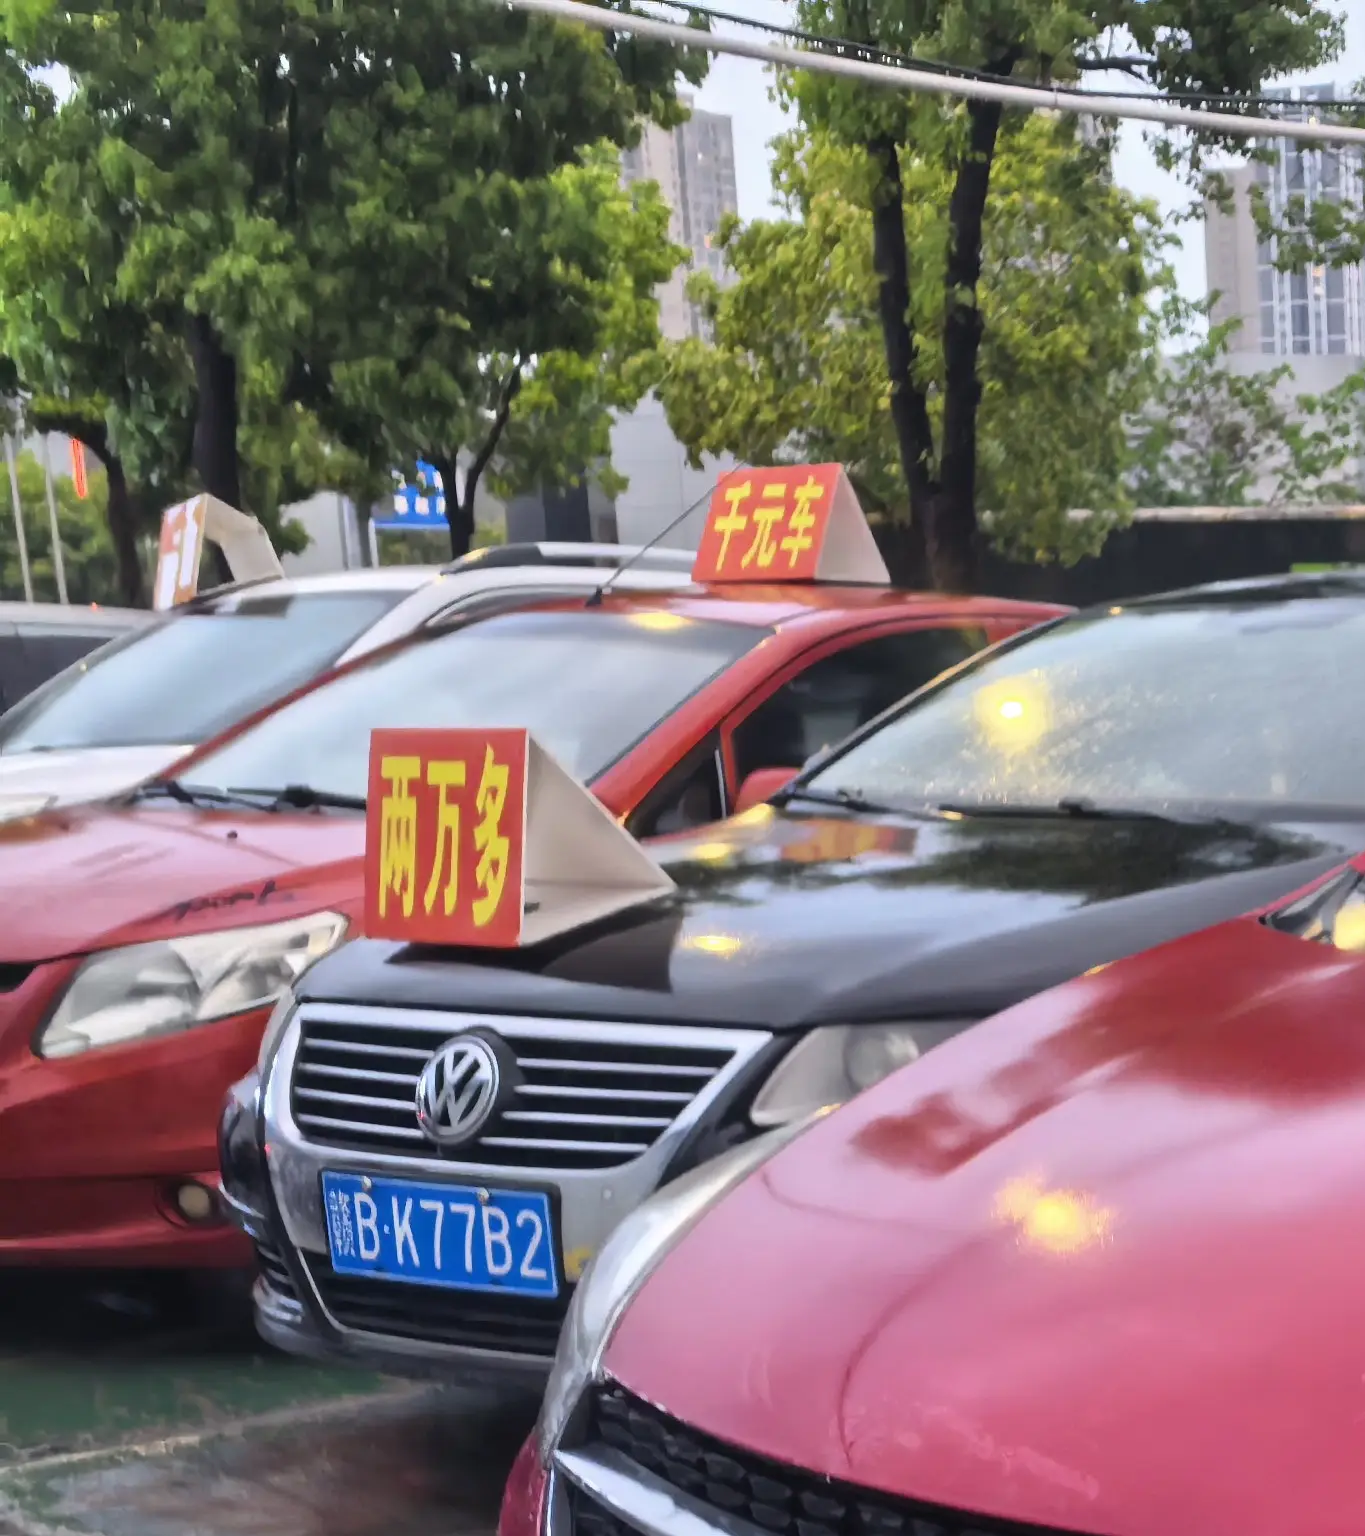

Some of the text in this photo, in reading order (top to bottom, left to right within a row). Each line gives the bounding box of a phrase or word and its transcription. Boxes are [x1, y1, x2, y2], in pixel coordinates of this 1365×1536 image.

[714, 475, 824, 572] 千元车
[379, 742, 510, 927] 两万多
